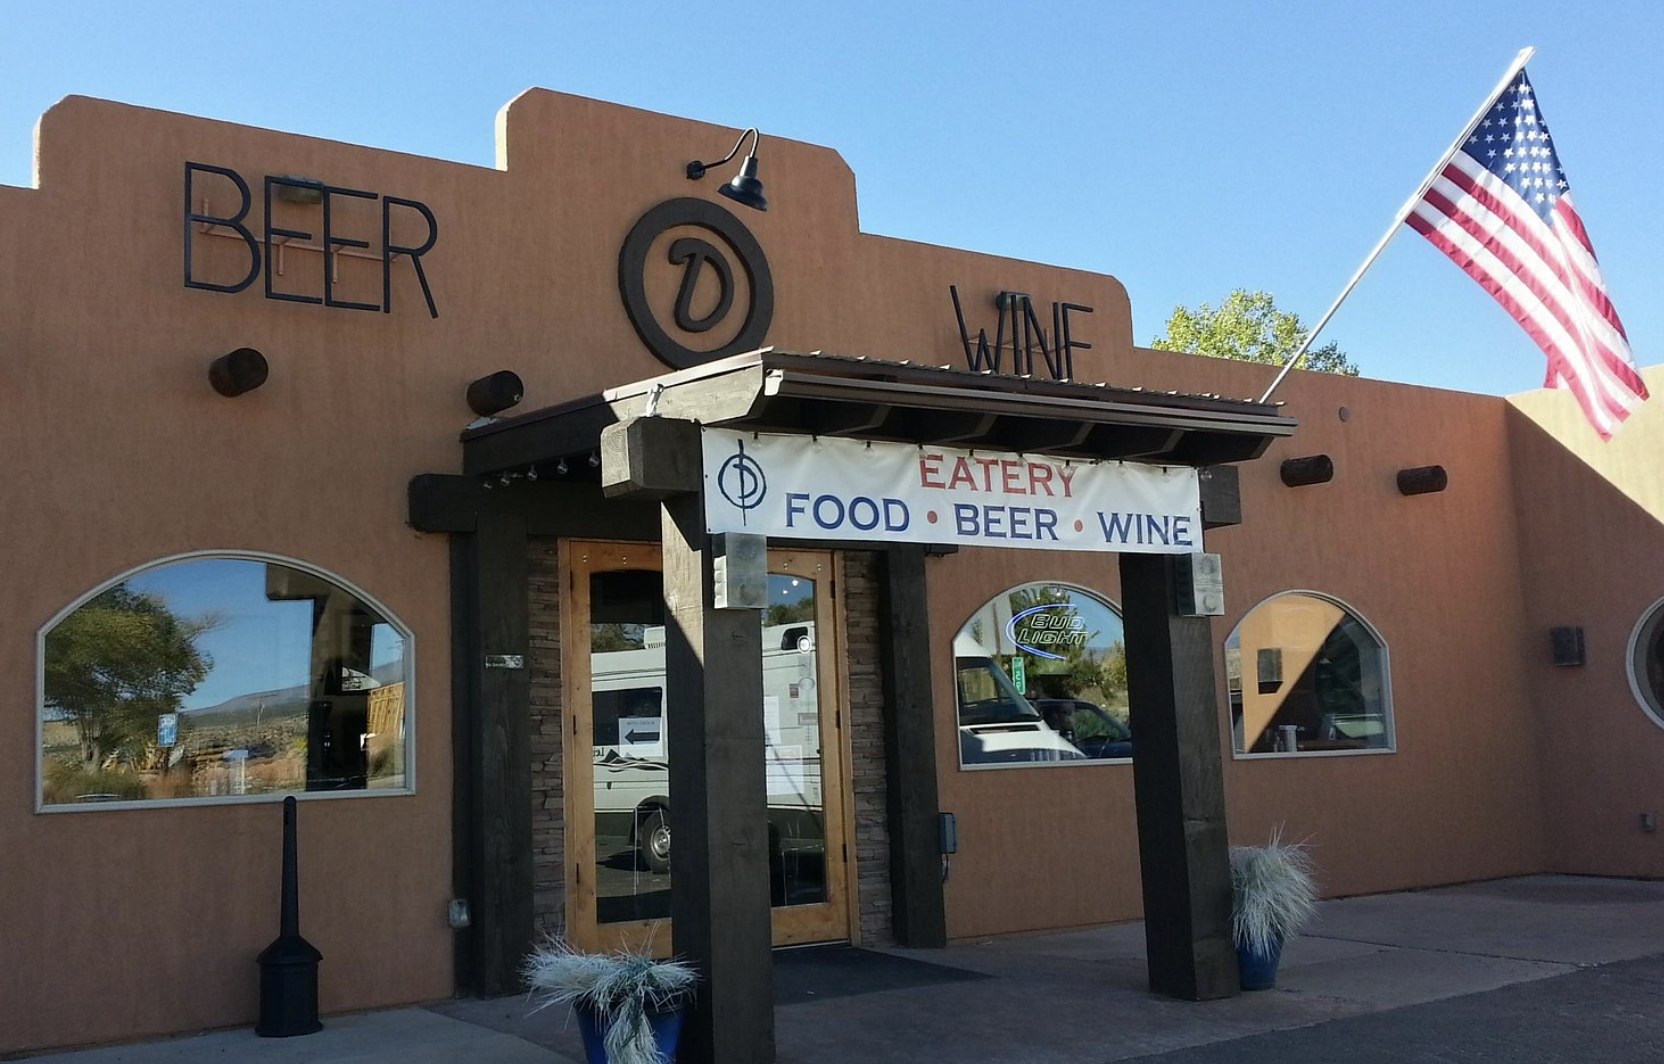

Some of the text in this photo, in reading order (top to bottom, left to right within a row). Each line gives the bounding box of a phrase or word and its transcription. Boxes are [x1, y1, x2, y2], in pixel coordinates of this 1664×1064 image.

[184, 161, 438, 319] BEER
[919, 454, 1079, 498] EATERY
[785, 492, 1193, 547] FOOD BEER WINE
[1017, 629, 1089, 644] LIGHT
[1031, 613, 1085, 630] BUD
